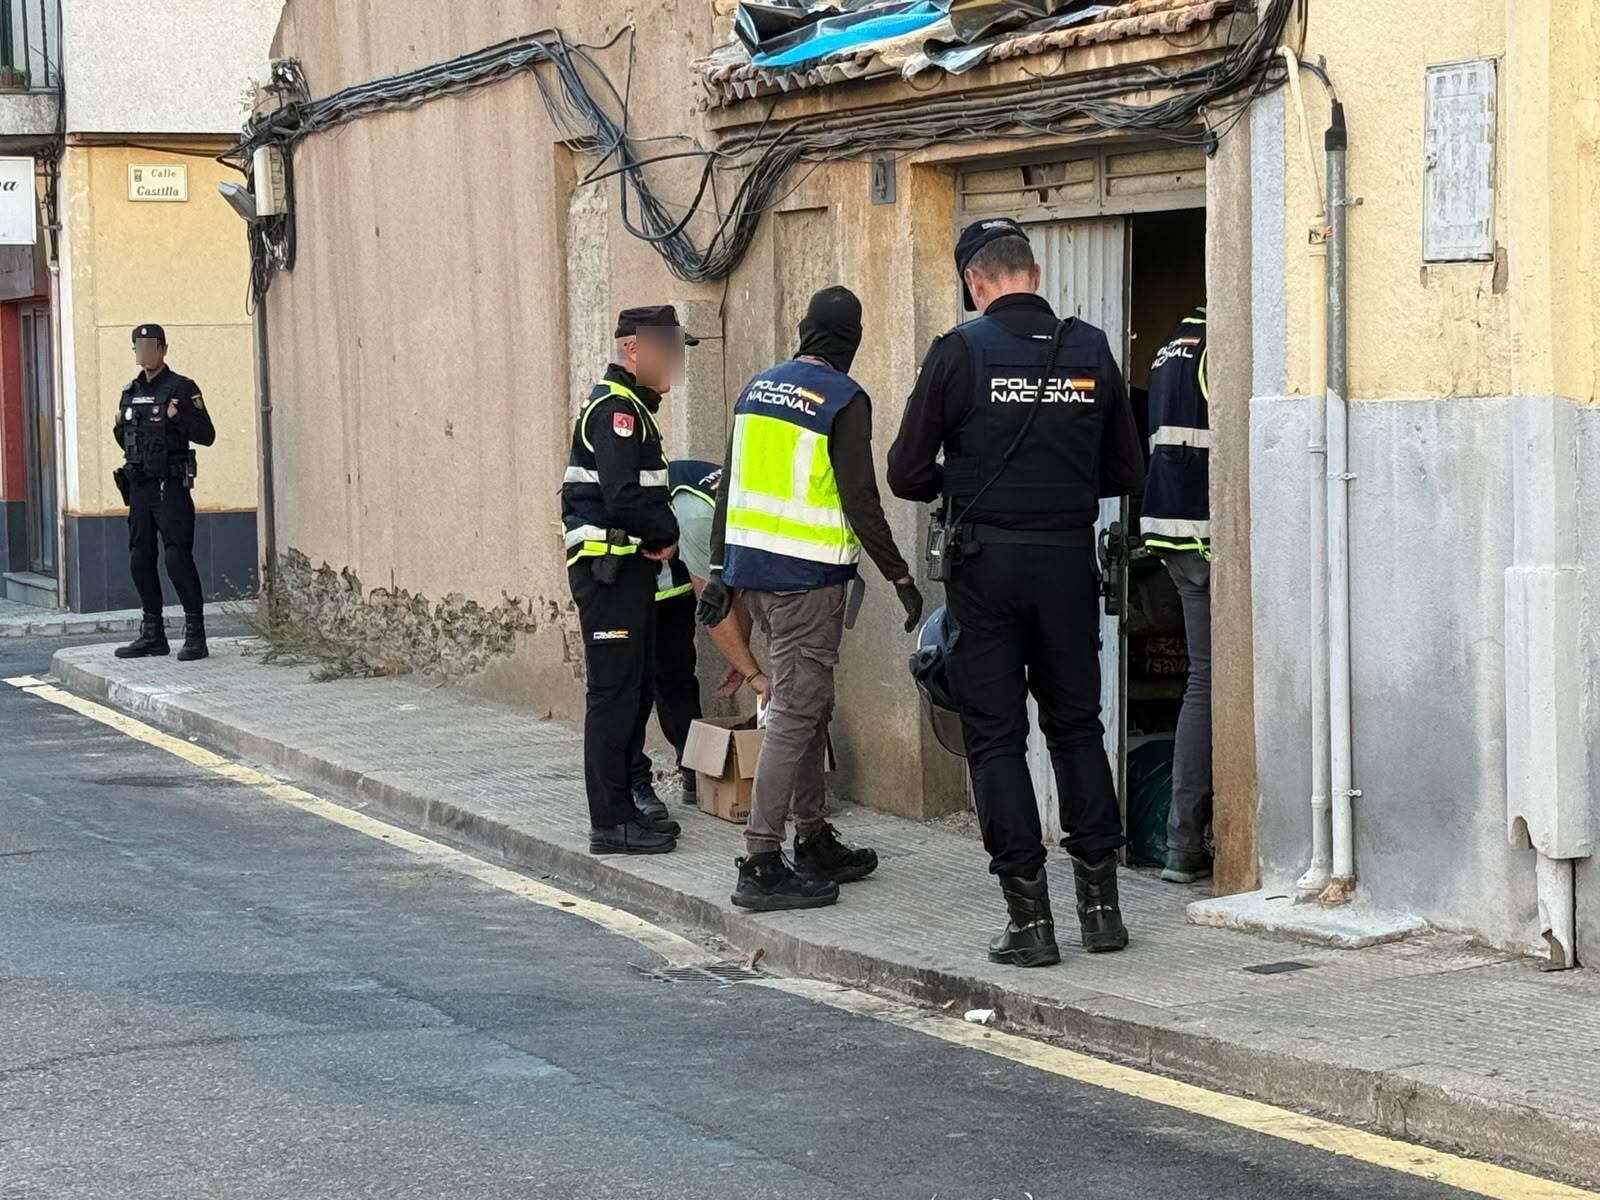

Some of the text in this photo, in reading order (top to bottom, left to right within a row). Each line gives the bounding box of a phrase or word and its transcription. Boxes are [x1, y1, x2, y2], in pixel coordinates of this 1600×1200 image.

[151, 169, 177, 178] Calle
[137, 186, 179, 196] Castilla
[752, 380, 803, 397] POLICIA
[991, 378, 1076, 390] POLICIA
